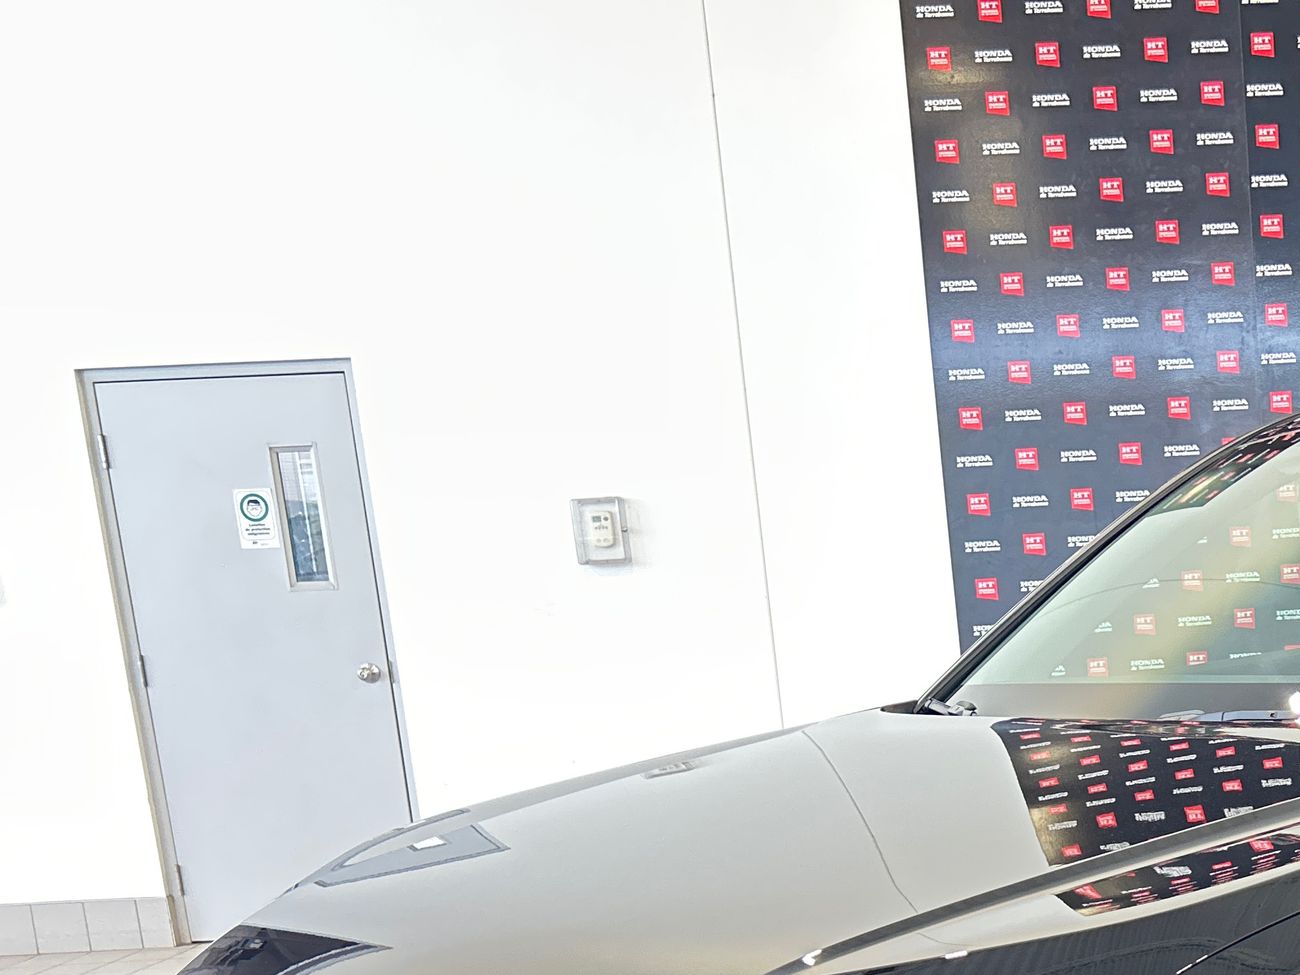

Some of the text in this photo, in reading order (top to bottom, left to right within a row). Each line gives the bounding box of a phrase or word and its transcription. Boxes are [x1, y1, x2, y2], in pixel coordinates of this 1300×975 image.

[1025, 0, 1063, 8] HONDA
[916, 5, 954, 13] HONDA
[1191, 40, 1228, 49] HONDA
[1083, 45, 1120, 53] HONDA
[975, 49, 1012, 58] HONDA
[1247, 83, 1283, 92] HONDA
[1032, 94, 1070, 102] HONDA
[924, 99, 962, 107] HONDA
[1090, 137, 1127, 145] HONDA
[1251, 174, 1288, 183] HONDA
[1146, 180, 1183, 189] HONDA
[1040, 185, 1076, 193] HONDA
[1202, 222, 1239, 231] HONDA
[1096, 228, 1133, 236] HONDA
[1256, 264, 1292, 272] HONDA
[1152, 270, 1188, 278] HONDA
[940, 280, 977, 288] HONDA
[1109, 404, 1145, 412] HONDA
[1164, 445, 1200, 453] HONDA
[1061, 450, 1096, 458] HONDA
[957, 455, 992, 463] HONDA
[1013, 495, 1048, 503] HONDA
